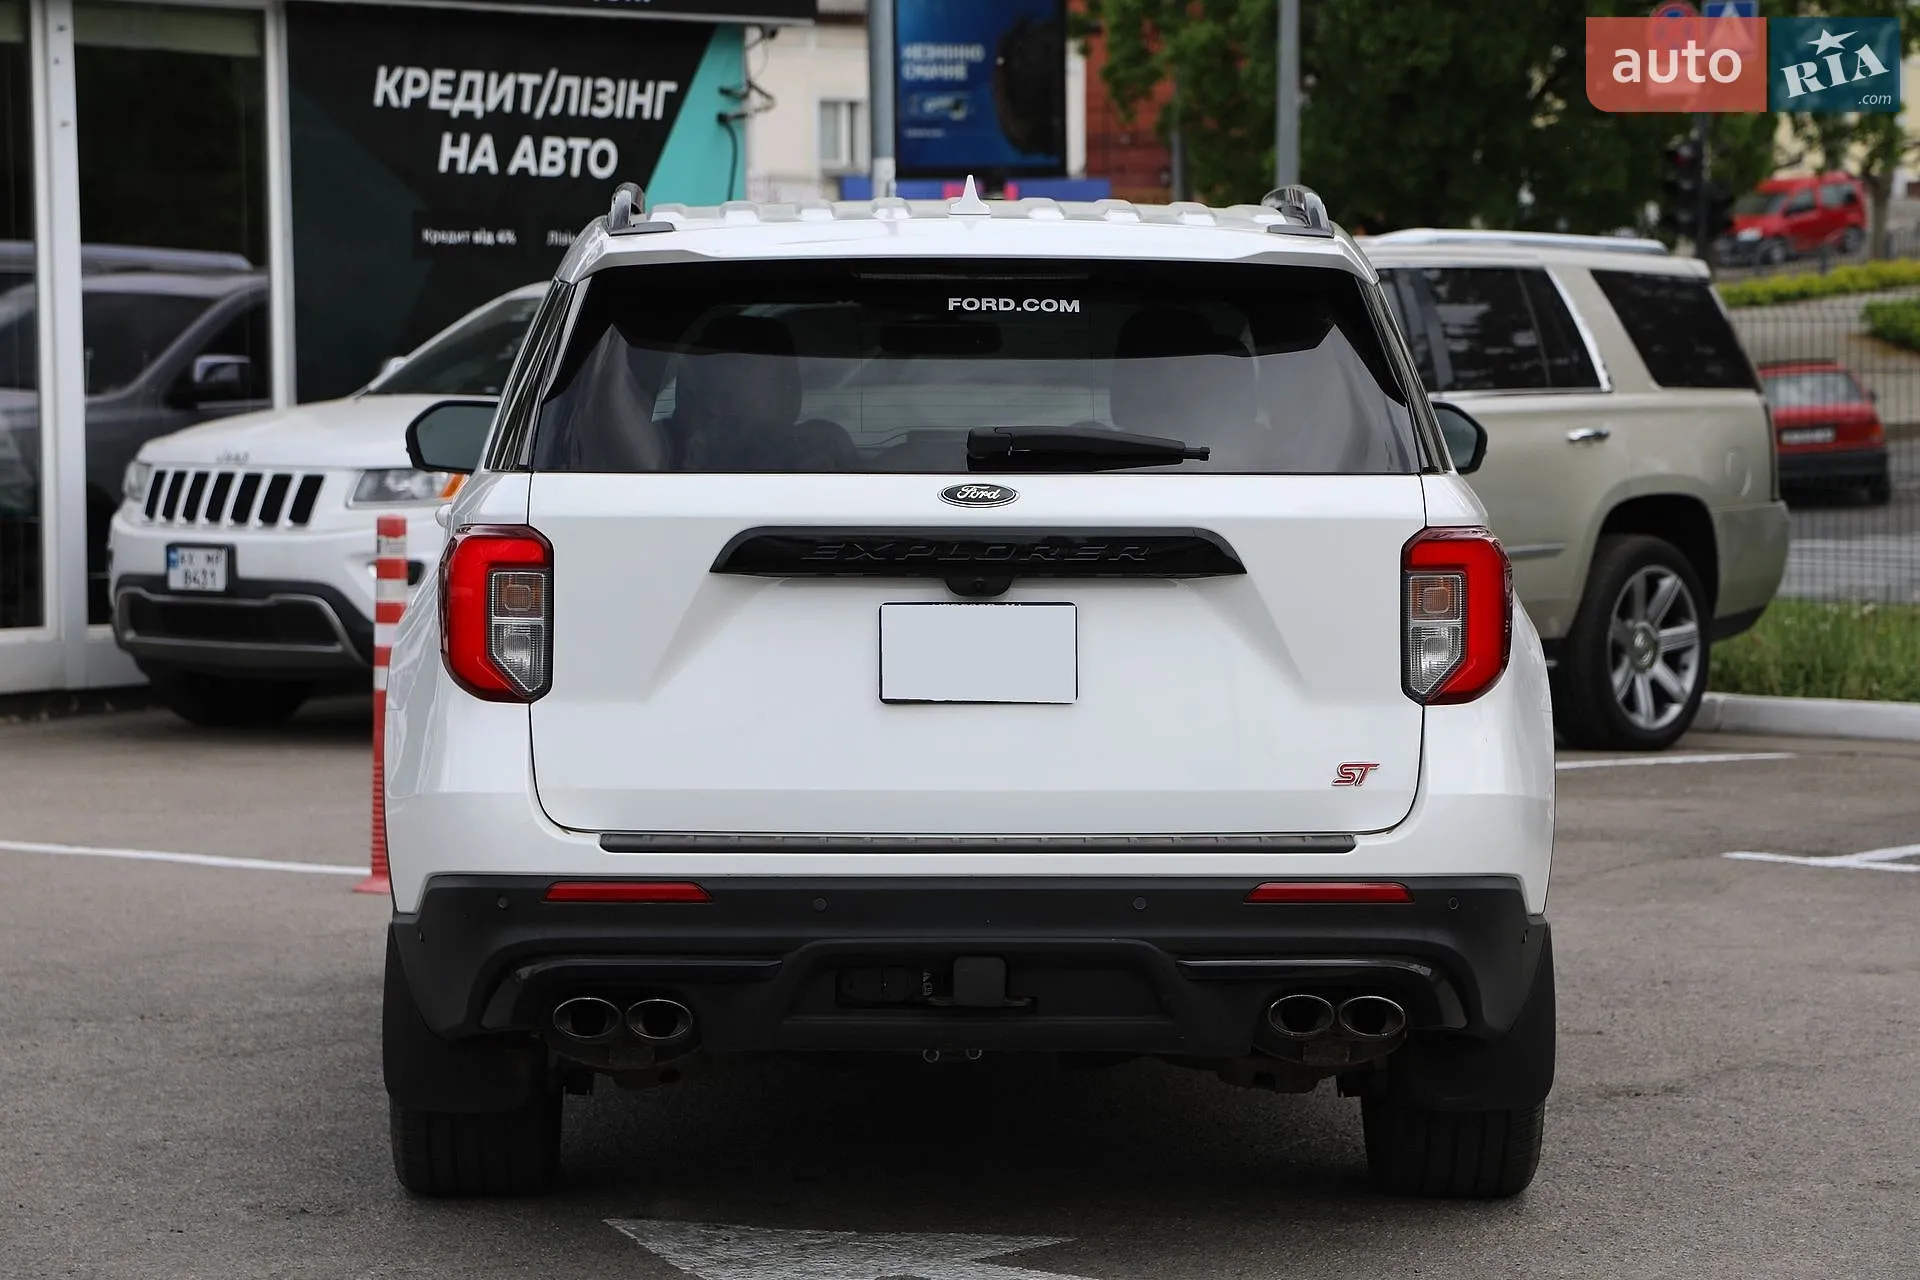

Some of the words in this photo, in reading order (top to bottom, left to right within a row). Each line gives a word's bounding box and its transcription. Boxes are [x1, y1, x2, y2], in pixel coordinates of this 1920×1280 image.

[373, 65, 678, 120] КРЕДИТ/ЛІЗІНГ
[437, 132, 499, 175] НА
[507, 135, 619, 180] АВТО
[421, 227, 470, 245] Кредит
[472, 226, 495, 246] від
[948, 297, 1081, 313] FORD.COM
[956, 485, 1001, 500] Ford
[801, 543, 1150, 561] EXPLORER
[1331, 762, 1380, 787] ST
